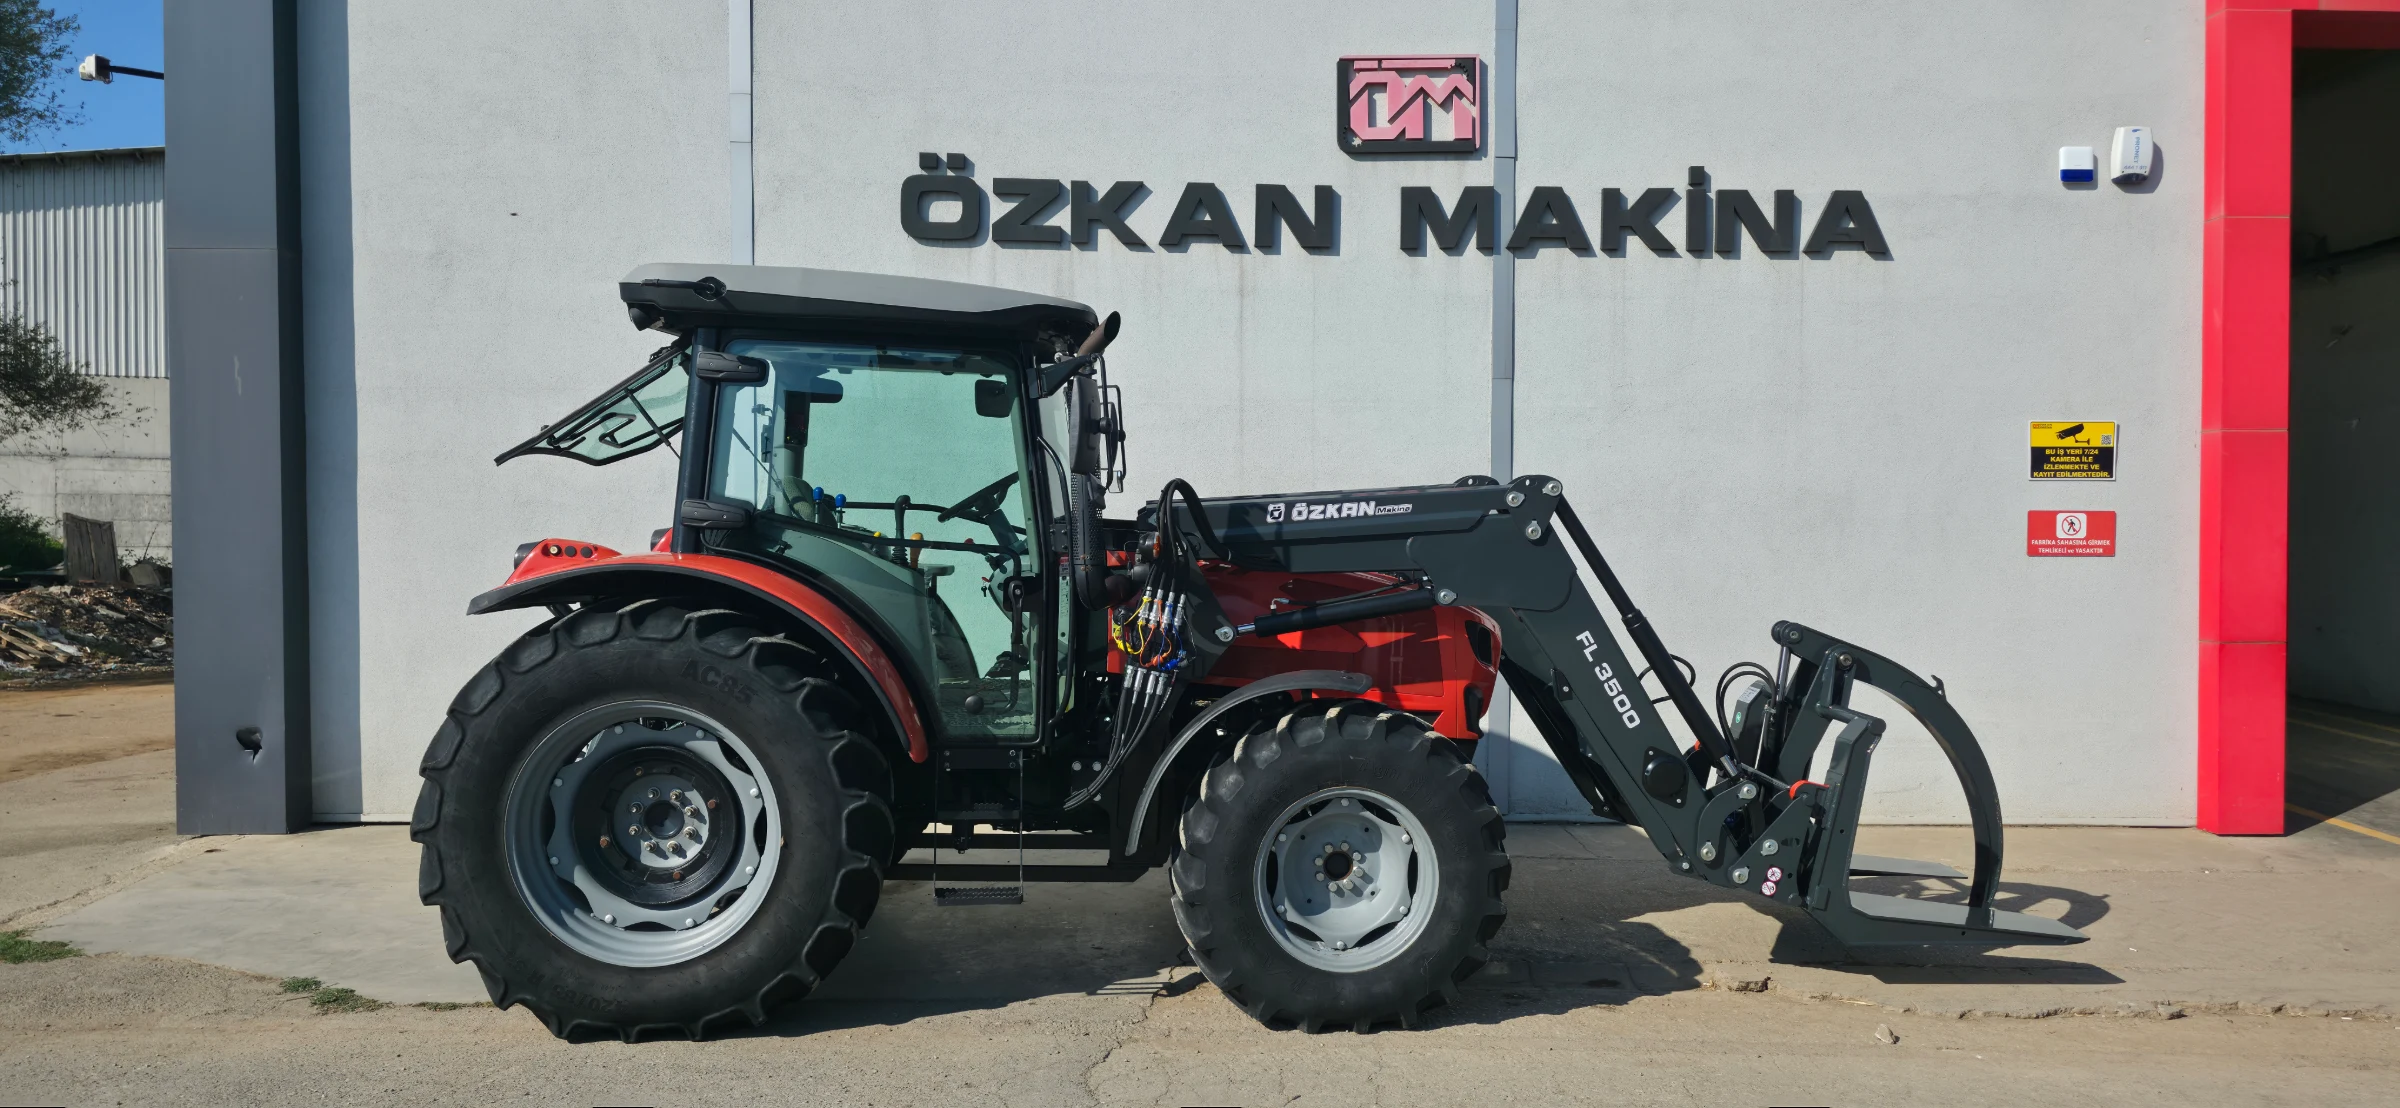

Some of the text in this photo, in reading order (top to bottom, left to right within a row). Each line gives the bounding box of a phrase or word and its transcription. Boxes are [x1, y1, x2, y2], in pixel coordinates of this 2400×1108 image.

[900, 152, 1886, 254] ÖZKAN MAKİNA
[1291, 501, 1411, 521] ÖZKAN Makina
[2088, 538, 2111, 546] GİRMEK
[680, 658, 753, 704] AC85
[1575, 630, 1641, 729] FL 3500
